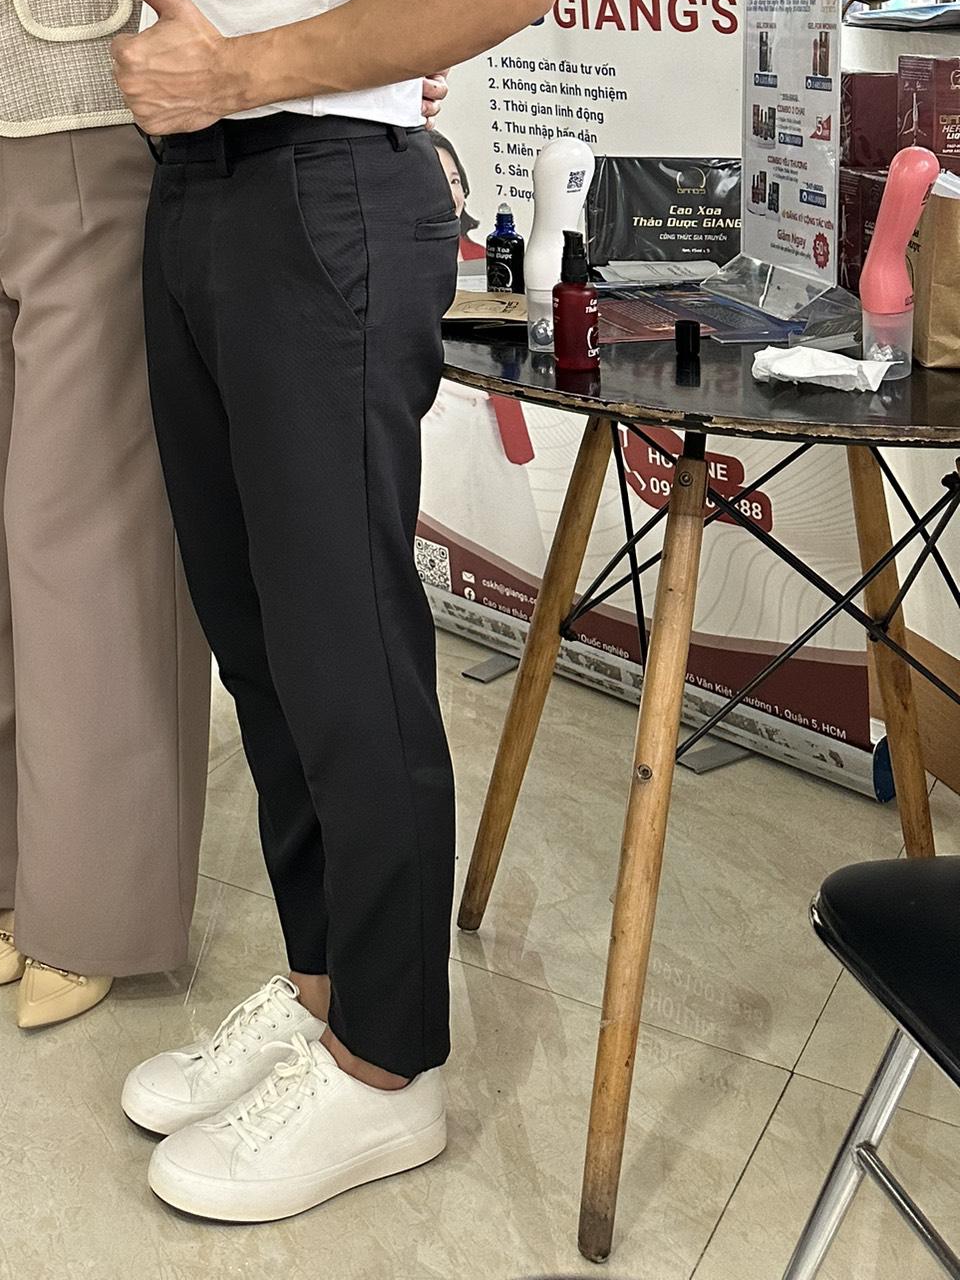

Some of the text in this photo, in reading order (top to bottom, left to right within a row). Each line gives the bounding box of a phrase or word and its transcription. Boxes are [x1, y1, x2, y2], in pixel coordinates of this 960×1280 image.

[487, 57, 616, 76] 1. Không cần đầu tư vốn
[488, 78, 628, 102] 2. Không cần kinh nghiệm
[490, 99, 604, 124] 3. Thời gian linh động
[491, 121, 502, 132] 4.
[505, 121, 526, 134] Thu
[529, 124, 554, 140] nhập
[493, 142, 504, 153] 5.
[495, 163, 529, 177] 6. Sản
[496, 185, 507, 196] 7.
[669, 205, 722, 215] Cao Xoa
[632, 216, 662, 227] Thảo
[696, 676, 713, 690] Văn
[784, 709, 809, 726] Quận
[822, 723, 847, 739] HCM
